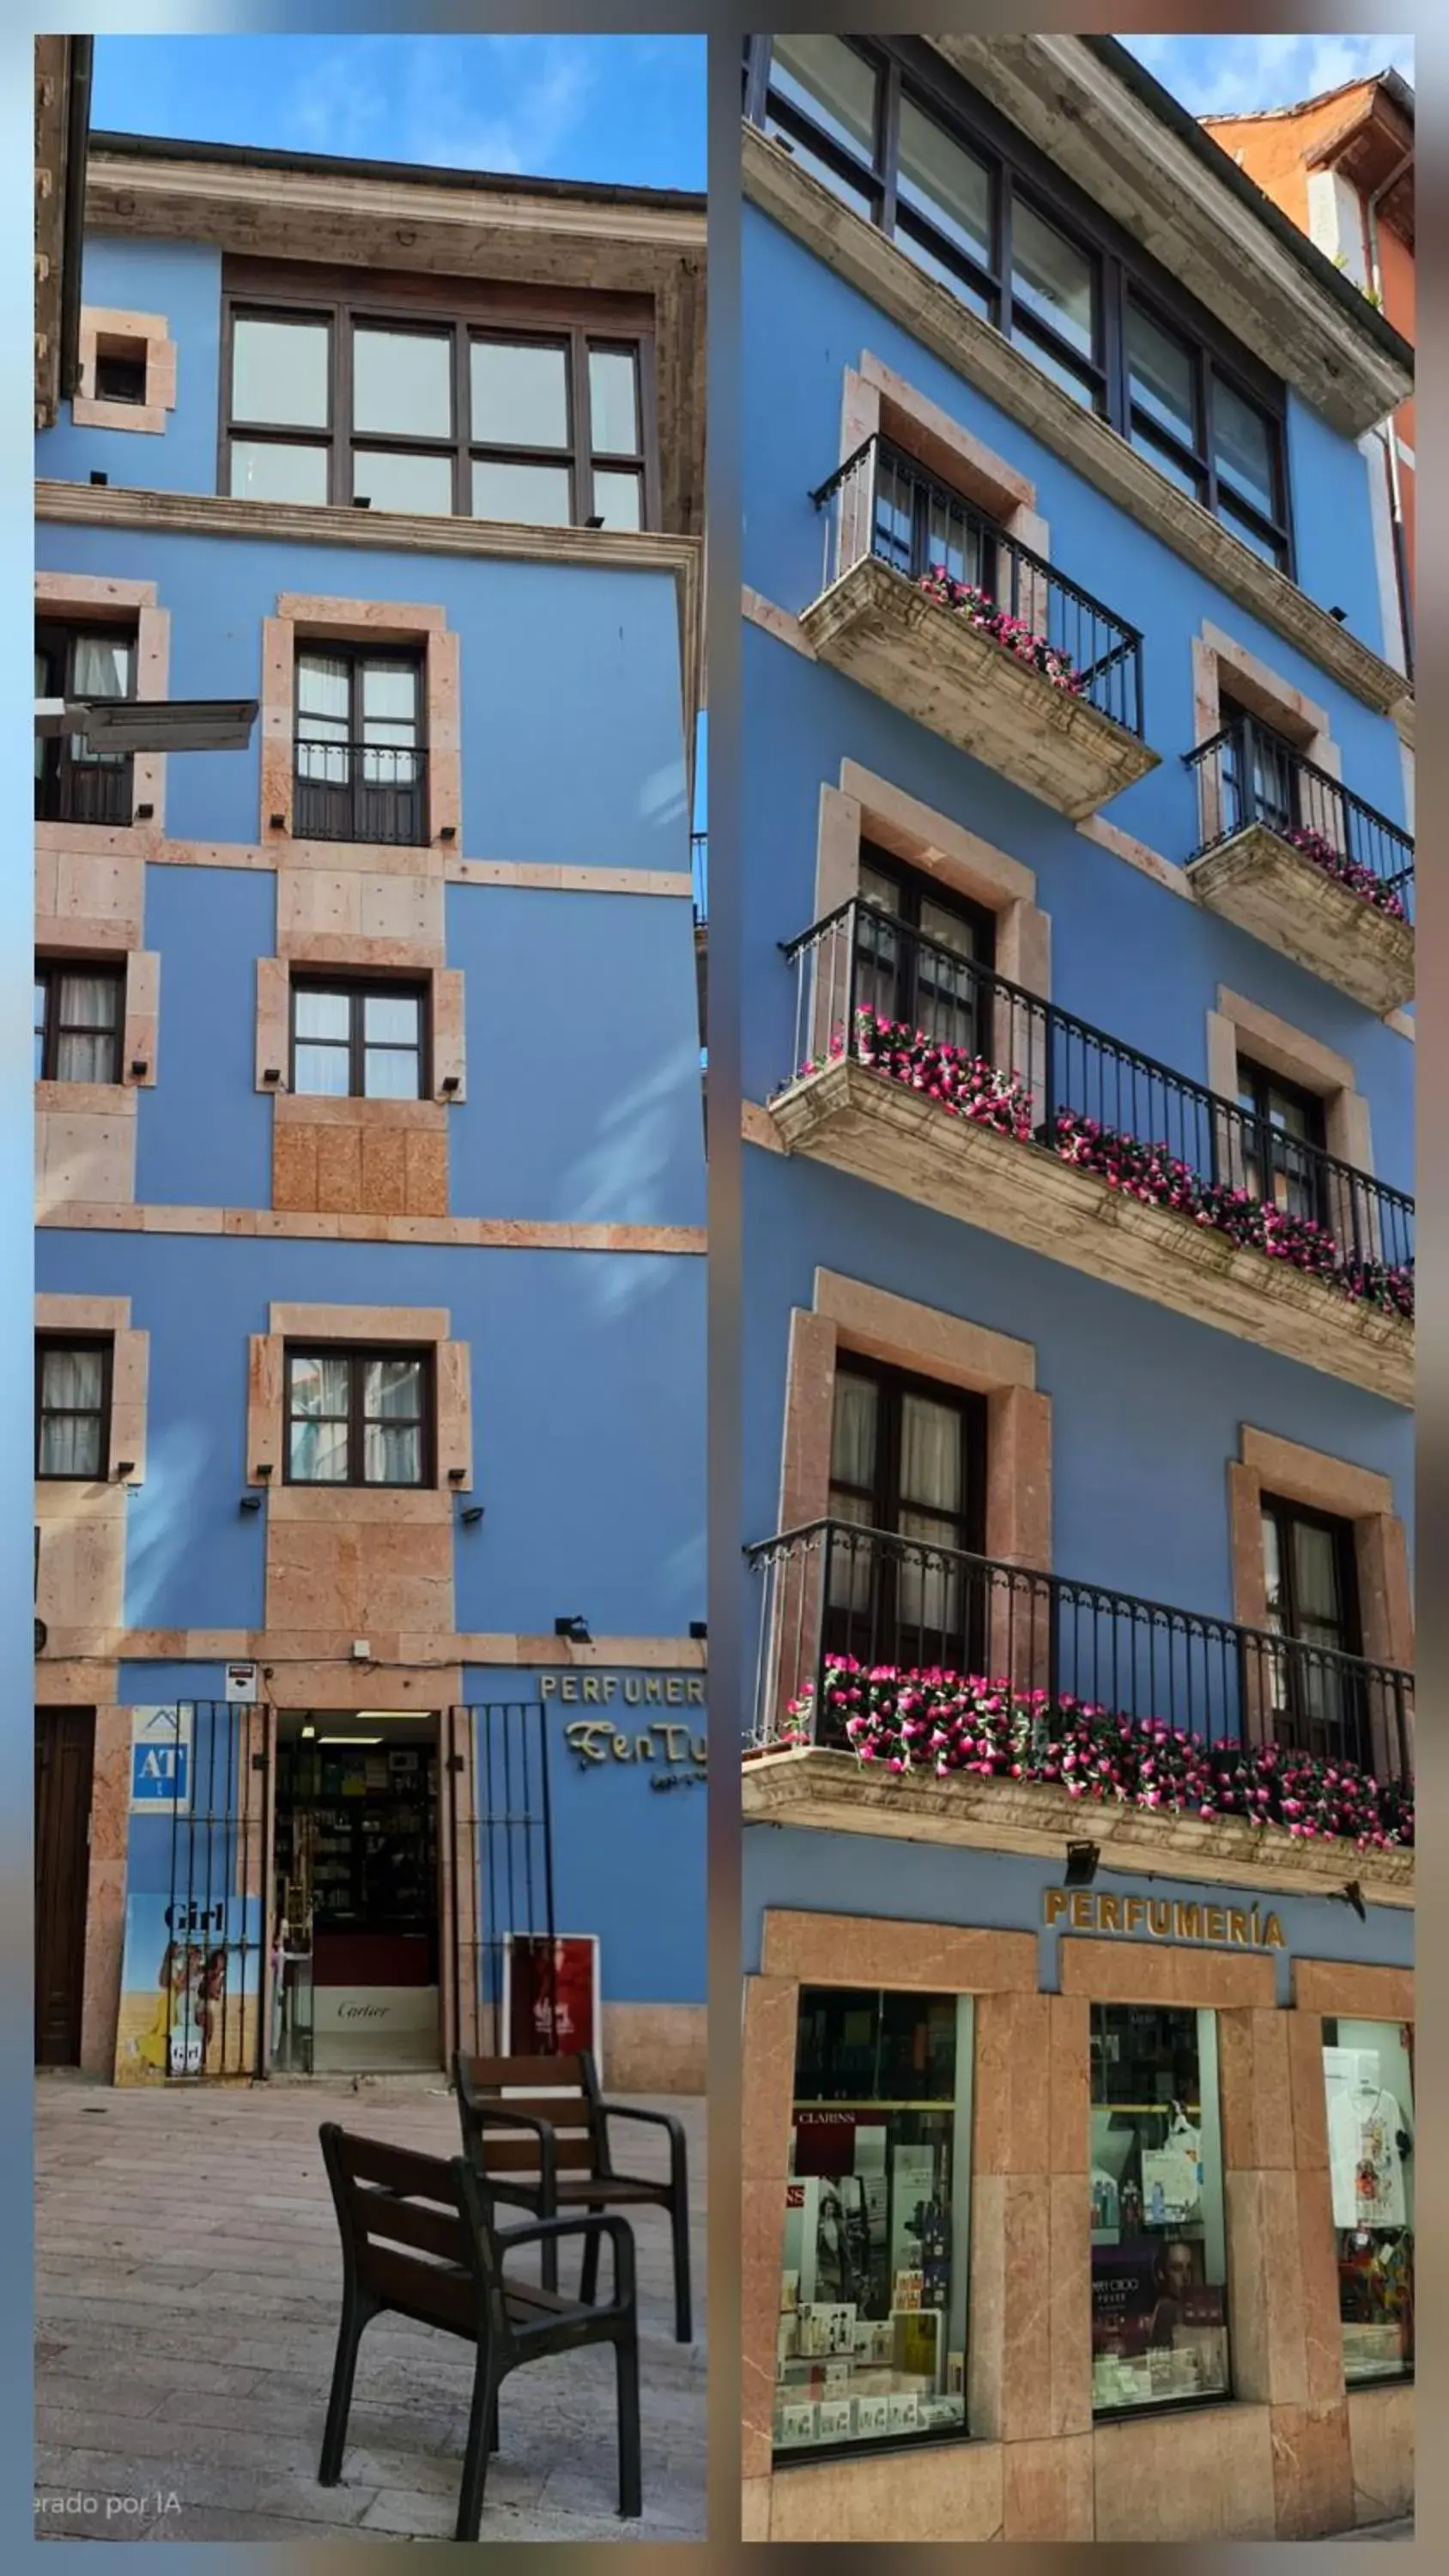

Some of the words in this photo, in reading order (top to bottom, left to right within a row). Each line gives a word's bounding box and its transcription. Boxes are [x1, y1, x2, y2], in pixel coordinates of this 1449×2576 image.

[540, 1675, 705, 1704] PERFUMER
[138, 1749, 184, 1778] AT
[164, 1901, 224, 1931] Girl
[1044, 1887, 1286, 1949] PERFUMERÍA
[337, 2001, 391, 2018] Cartier
[798, 2112, 856, 2123] CLARINS
